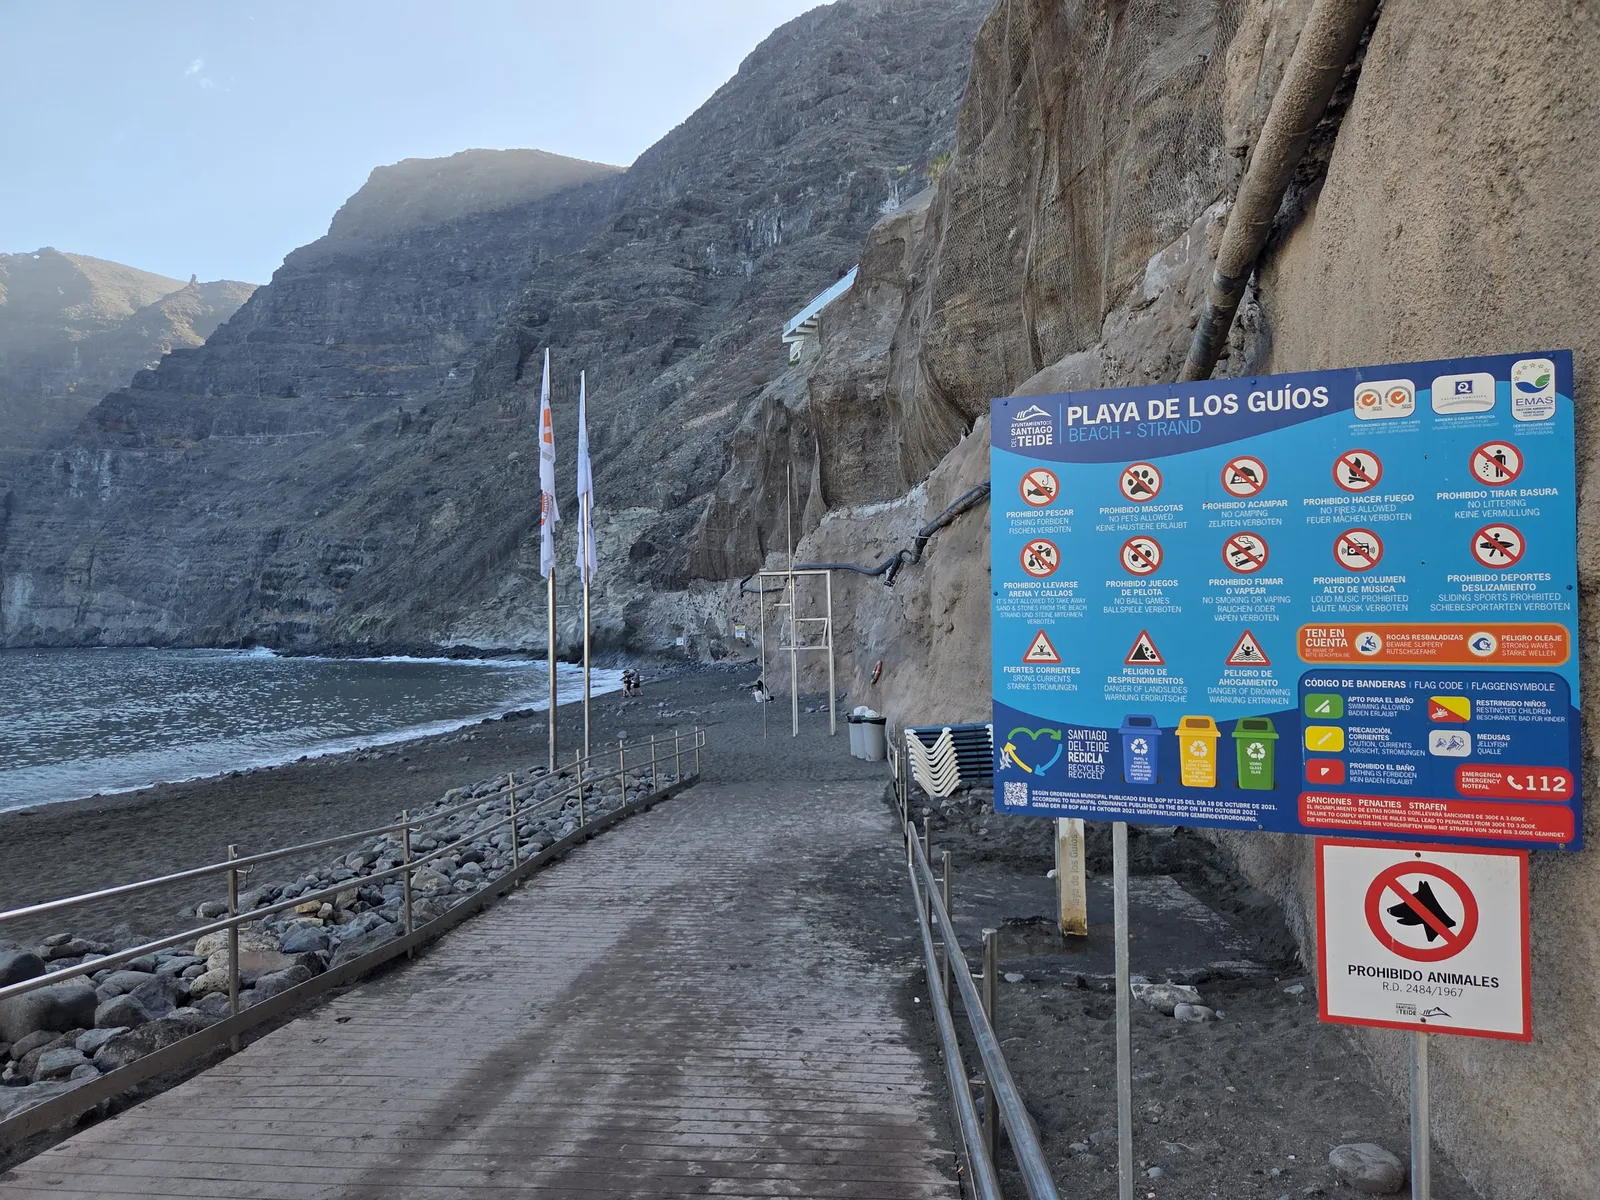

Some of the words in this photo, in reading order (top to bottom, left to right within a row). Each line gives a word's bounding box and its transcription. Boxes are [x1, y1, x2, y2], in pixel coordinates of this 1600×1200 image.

[1068, 402, 1138, 425] PLAYA
[1148, 398, 1179, 422] DE
[1188, 393, 1238, 418] LOS
[1247, 384, 1328, 412] GUÍOS
[1516, 397, 1553, 405] EMAS
[1011, 425, 1052, 435] SANTIAGO
[1069, 424, 1119, 442] BEACH
[1137, 419, 1201, 437] STRAND
[1017, 435, 1052, 446] TEIDE
[1436, 490, 1487, 500] PROHIBIDO
[1489, 489, 1517, 497] TIRAR
[1520, 487, 1558, 496] BASURA
[1202, 501, 1245, 509] PROHIBIDO
[1247, 499, 1287, 508] ACAMPAR
[1303, 496, 1350, 505] PROHIBIDO
[1352, 495, 1381, 503] HACER
[1384, 493, 1414, 503] FUEGO
[1467, 500, 1480, 508] NO
[1483, 498, 1526, 508] LITTERING
[1006, 510, 1044, 518] PROHIBIDO
[1045, 508, 1073, 516] PESCAR
[1099, 506, 1139, 514] PROHIBIDO
[1141, 504, 1183, 512] MASCOTAS
[1221, 510, 1232, 518] NO
[1234, 509, 1268, 517] CAMPING
[1320, 506, 1332, 514] NO
[1334, 505, 1356, 515] FIRES
[1357, 503, 1396, 512] ALLOWED
[1010, 518, 1035, 526] FISHING
[1036, 517, 1068, 525] FORBIDEN
[1120, 514, 1138, 522] PETS
[1140, 513, 1173, 521] ALLOWED
[1242, 517, 1282, 526] VERBOTEN
[1254, 577, 1283, 585] FUMAR
[1313, 576, 1360, 584] PROHIBIDO
[1362, 575, 1405, 585] VOLUMEN
[1447, 573, 1498, 582] PROHIBIDO
[1500, 572, 1551, 581] DEPORTES
[1323, 583, 1344, 596] ALTO
[1346, 585, 1358, 596] DE
[1361, 582, 1396, 595] MÚSICA
[1461, 583, 1536, 591] DESLIZAMIENTO
[1008, 590, 1032, 598] ARENA
[1121, 588, 1131, 598] DE
[1114, 597, 1124, 606] NO
[1126, 597, 1143, 606] BALL
[1144, 596, 1169, 606] GAMES
[1202, 596, 1213, 604] NO
[1263, 595, 1290, 603] VAPING
[1304, 628, 1326, 639] TEN
[1328, 628, 1345, 639] EN
[1386, 634, 1410, 642] ROCAS
[1411, 634, 1463, 642] RESBALADIZAS
[1501, 634, 1532, 642] PELIGRO
[1305, 637, 1348, 647] CUENTA
[1035, 666, 1080, 674] CORRIENTES
[1122, 667, 1154, 675] PELIGRO
[1224, 669, 1258, 677] PELIGRO
[1260, 669, 1272, 677] DE
[1012, 674, 1035, 683] SRONG
[1036, 674, 1071, 683] CURRENTS
[1107, 676, 1184, 684] DESPRENDIMIENTOS
[1218, 678, 1278, 686] AHOGAMIENTO
[1304, 677, 1339, 687] CÓDIGO
[1341, 679, 1353, 687] DE
[1356, 680, 1406, 688] BANDERAS
[1414, 680, 1436, 689] FLAG
[1438, 681, 1463, 689] CODE
[1471, 681, 1555, 691] FLAGGENSYMBOLE
[1207, 686, 1236, 694] DANGER
[1250, 687, 1290, 696] DROWNING
[1347, 696, 1365, 705] APTO
[1366, 696, 1384, 705] PARA
[1384, 697, 1394, 705] EL
[1393, 696, 1414, 705] BAÑO
[1476, 699, 1522, 709] RESTRINGIDO
[1523, 699, 1546, 709] NIÑOS
[1348, 702, 1379, 711] SWIMMING
[1518, 707, 1551, 716] CHILDREN
[1068, 729, 1107, 741] SANTIAGO
[1348, 733, 1389, 741] CORRIENTES
[1476, 733, 1510, 742] MEDUSAS
[1068, 741, 1085, 752] DEL
[1085, 741, 1109, 752] TEIDE
[1477, 740, 1507, 749] JELLYFISH
[1476, 747, 1501, 755] QUALLE
[1068, 752, 1103, 764] RECICLA
[1068, 764, 1105, 772] RECYCLES
[1349, 762, 1385, 772] PROHIBIDO
[1385, 764, 1394, 772] EL
[1394, 763, 1415, 773] BAÑO
[1068, 771, 1104, 779] RECYCELT
[1461, 771, 1502, 779] EMERGENCIA
[1462, 777, 1500, 785] EMERGENCY
[1526, 775, 1566, 792] 112
[1306, 796, 1352, 806] SANCIONES
[1359, 798, 1401, 808] PENALTIES
[1409, 802, 1446, 811] STRAFEN
[1069, 860, 1078, 873] los
[1070, 875, 1079, 886] de
[1348, 964, 1422, 981] PROHIBIDO
[1427, 971, 1499, 988] ANIMALES
[1382, 981, 1402, 992] R.D.
[1406, 983, 1463, 997] 2484/1967
